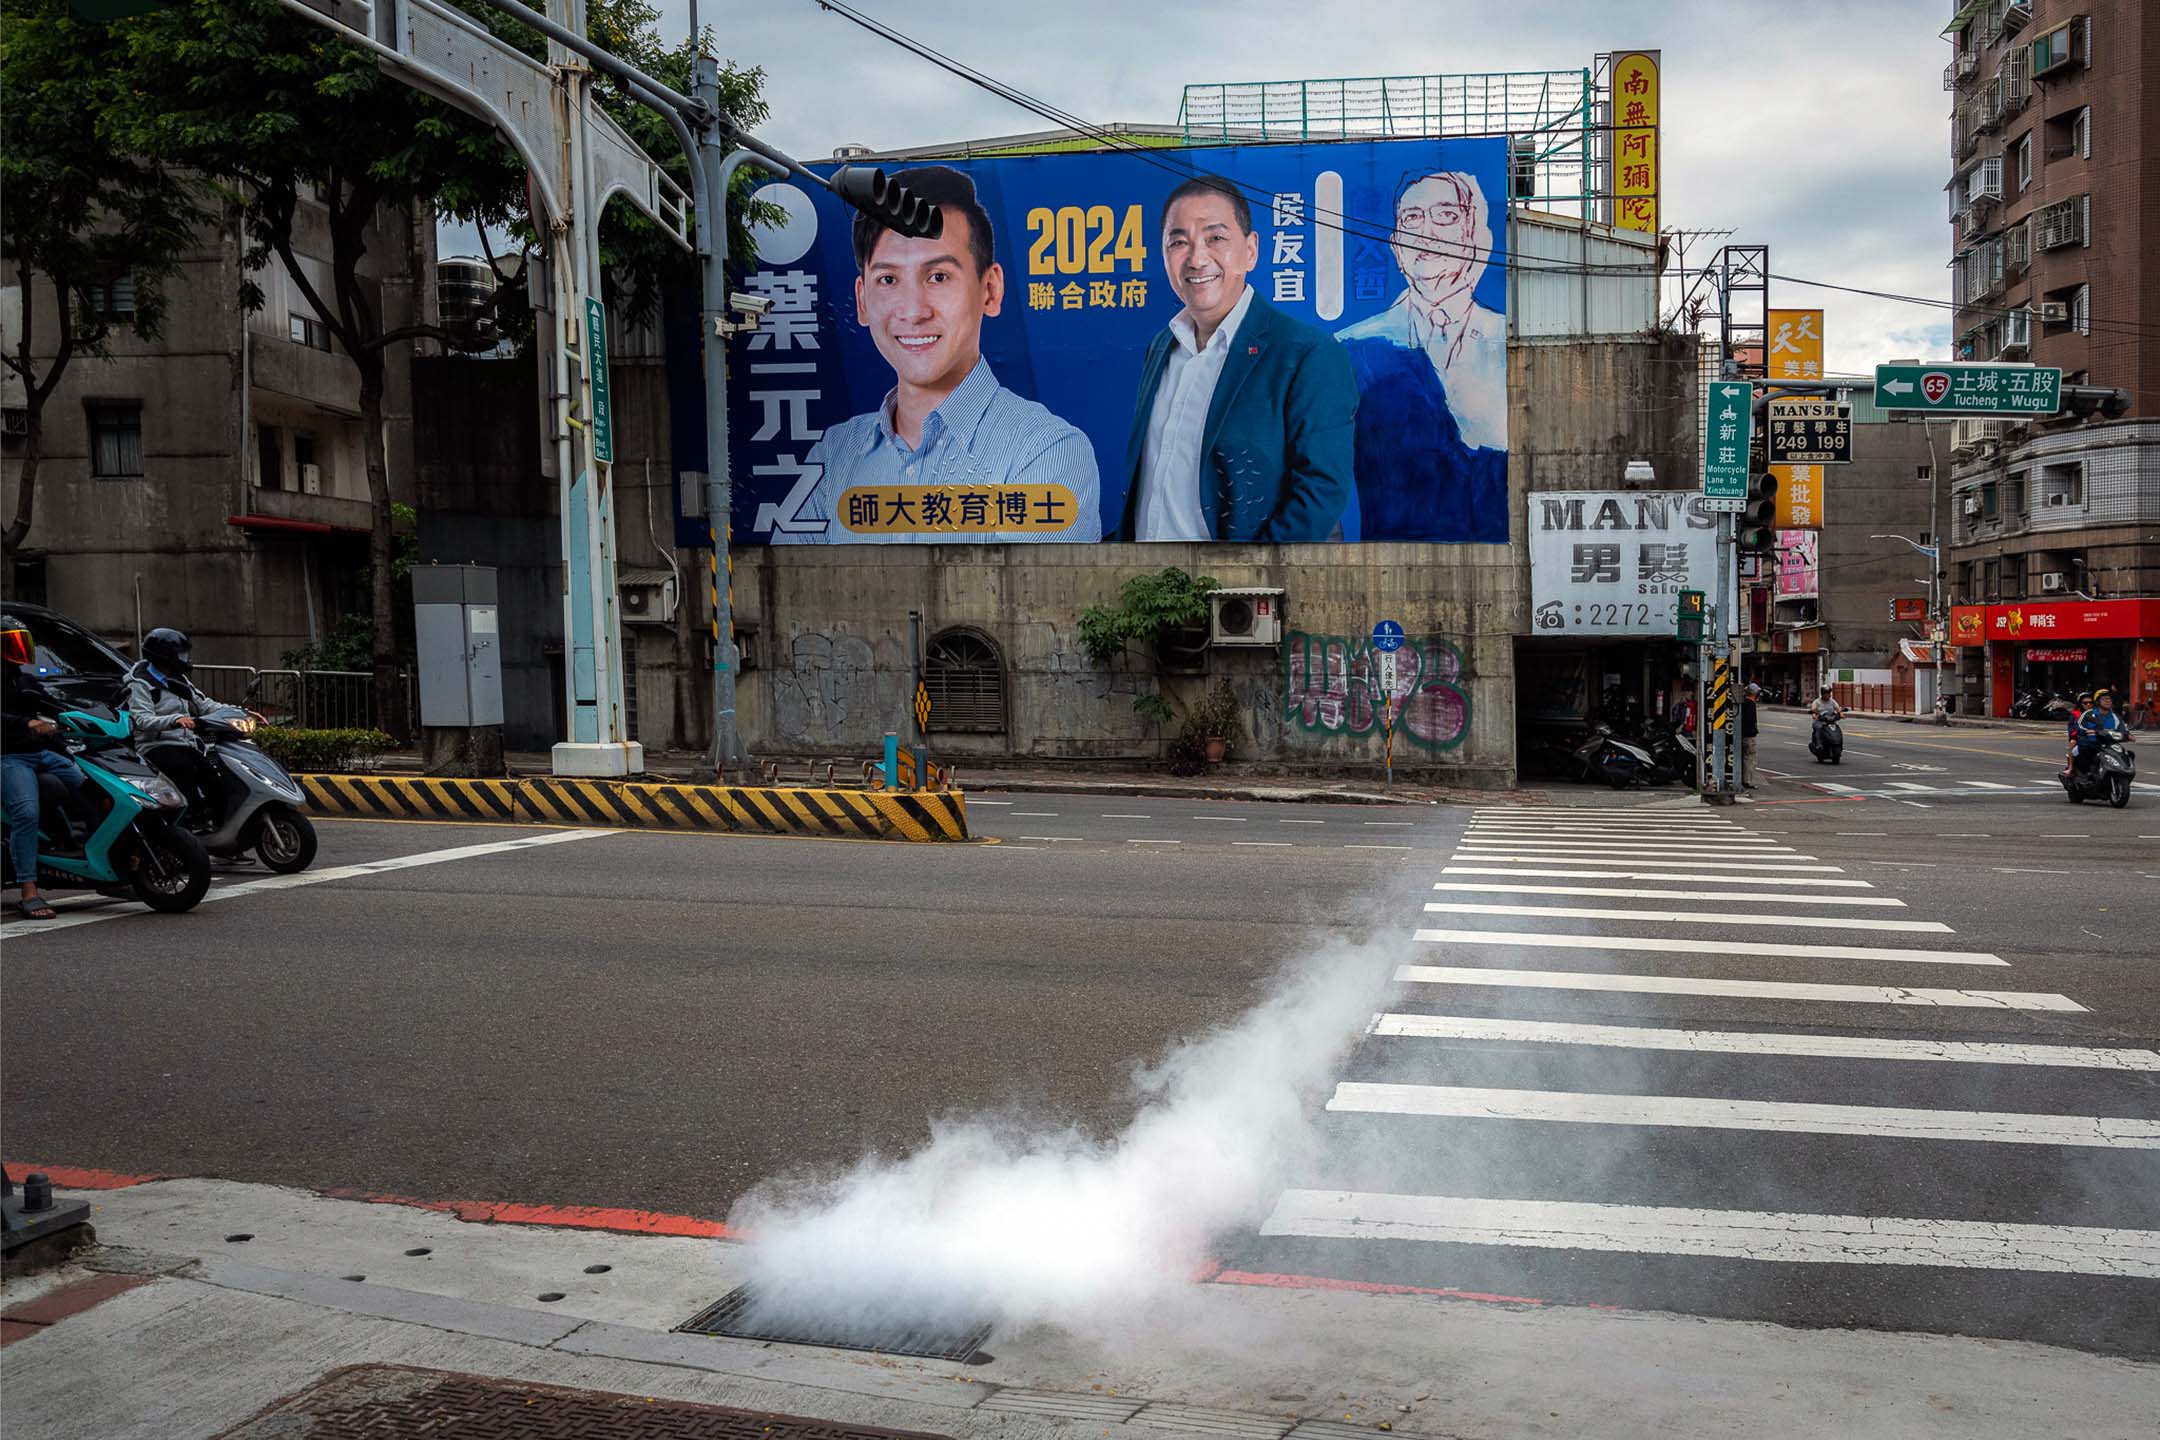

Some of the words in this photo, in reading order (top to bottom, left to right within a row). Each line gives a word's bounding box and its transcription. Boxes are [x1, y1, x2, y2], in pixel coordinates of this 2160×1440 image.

[1622, 69, 1651, 230] 南無阿彌陀
[1027, 204, 1147, 275] 2024
[1272, 192, 1306, 302] 侯友宜
[1029, 279, 1147, 310] 聯合政府
[1926, 379, 1945, 393] 65
[1954, 393, 1998, 409] Tucheng
[2011, 395, 2048, 410] Wugu
[744, 271, 830, 533] 葉元之
[1773, 405, 1822, 417] MAN'S
[1719, 424, 1737, 463] 新莊
[1776, 436, 1808, 449] 249
[1817, 436, 1845, 449] 199
[1707, 465, 1746, 475] Motorcycle
[1707, 476, 1724, 484] Lane
[1730, 476, 1737, 484] to
[1707, 486, 1744, 496] Xinzhuang
[849, 492, 1066, 527] 師大教育博士
[1541, 495, 1717, 530] MAN'S
[1691, 594, 1701, 612] 4
[1384, 654, 1394, 689] 行人優先
